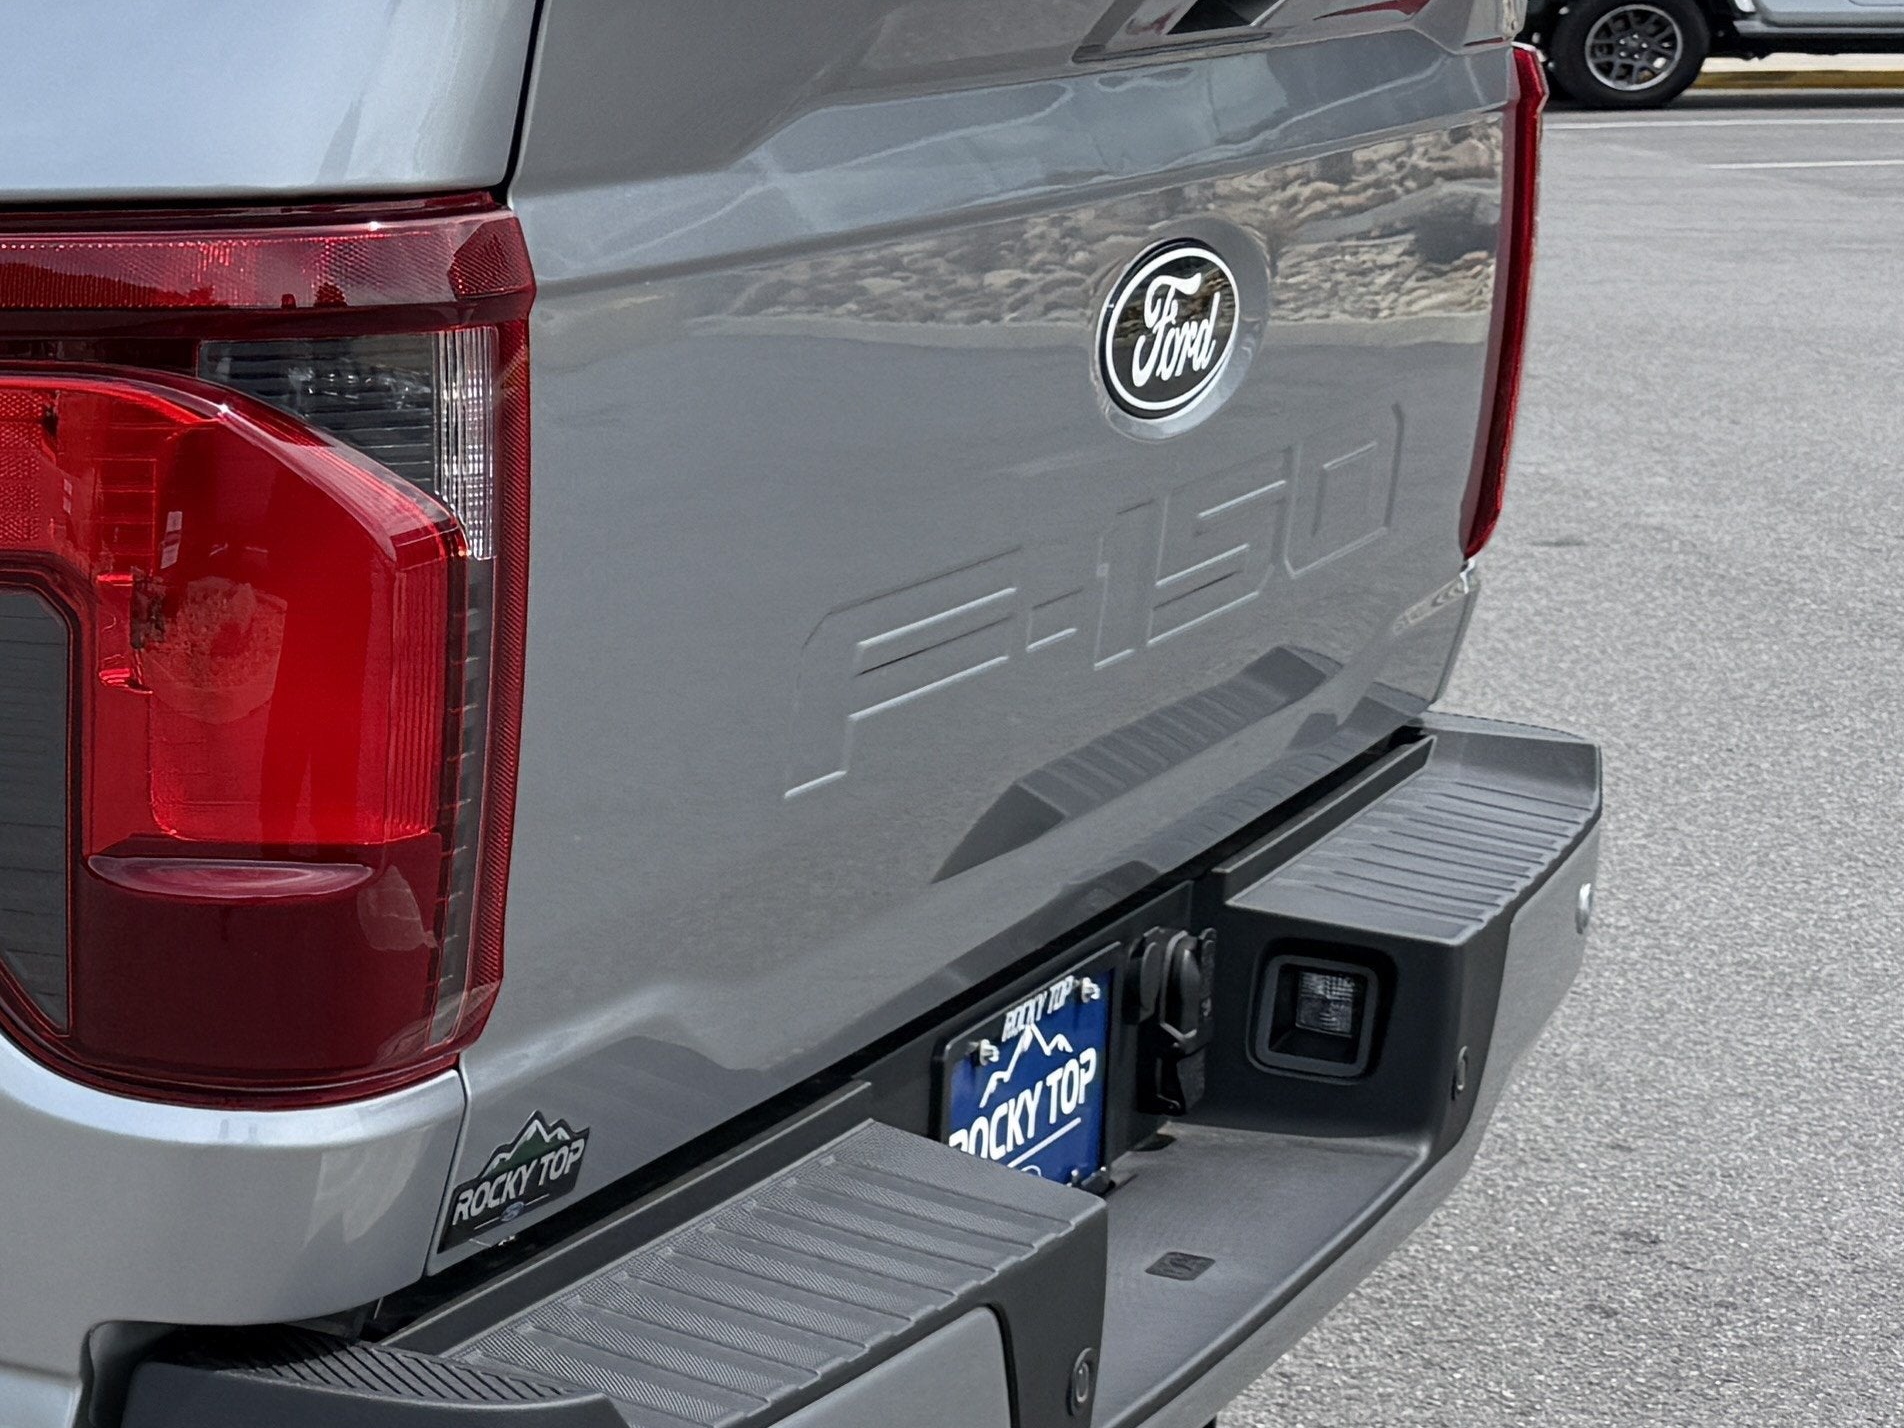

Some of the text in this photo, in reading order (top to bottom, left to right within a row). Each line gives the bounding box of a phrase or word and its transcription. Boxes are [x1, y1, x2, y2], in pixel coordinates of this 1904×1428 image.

[1131, 272, 1221, 388] Ford
[783, 402, 1405, 801] F-150
[1002, 975, 1075, 1042] ROCKY TOP
[1047, 1047, 1097, 1124] TOP
[452, 1138, 586, 1226] ROCKY TOP
